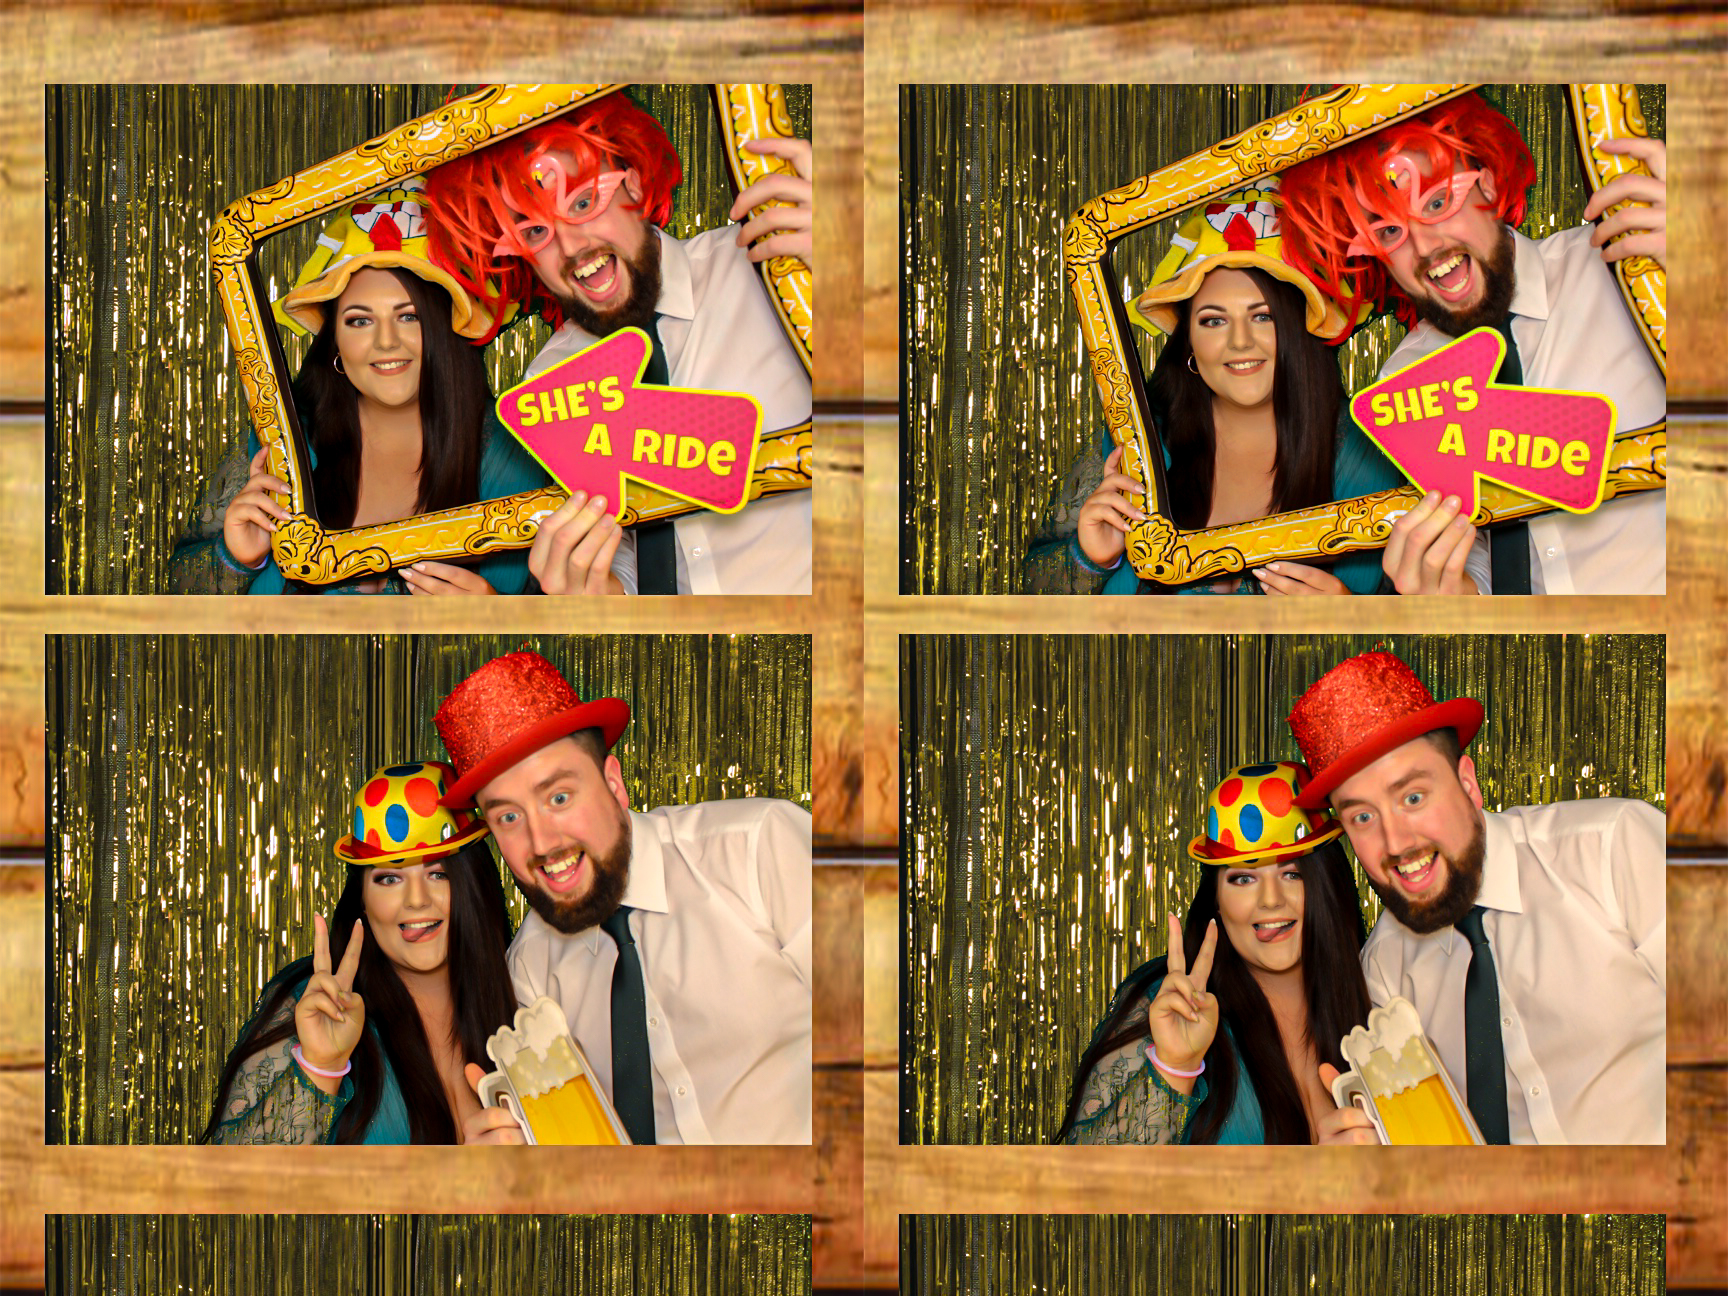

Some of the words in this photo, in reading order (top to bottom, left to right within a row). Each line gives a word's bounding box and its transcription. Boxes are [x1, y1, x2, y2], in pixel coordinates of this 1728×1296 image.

[516, 375, 625, 427] SHE'S
[1370, 375, 1479, 427] SHE'S
[583, 423, 613, 456] A
[1437, 423, 1467, 456] A
